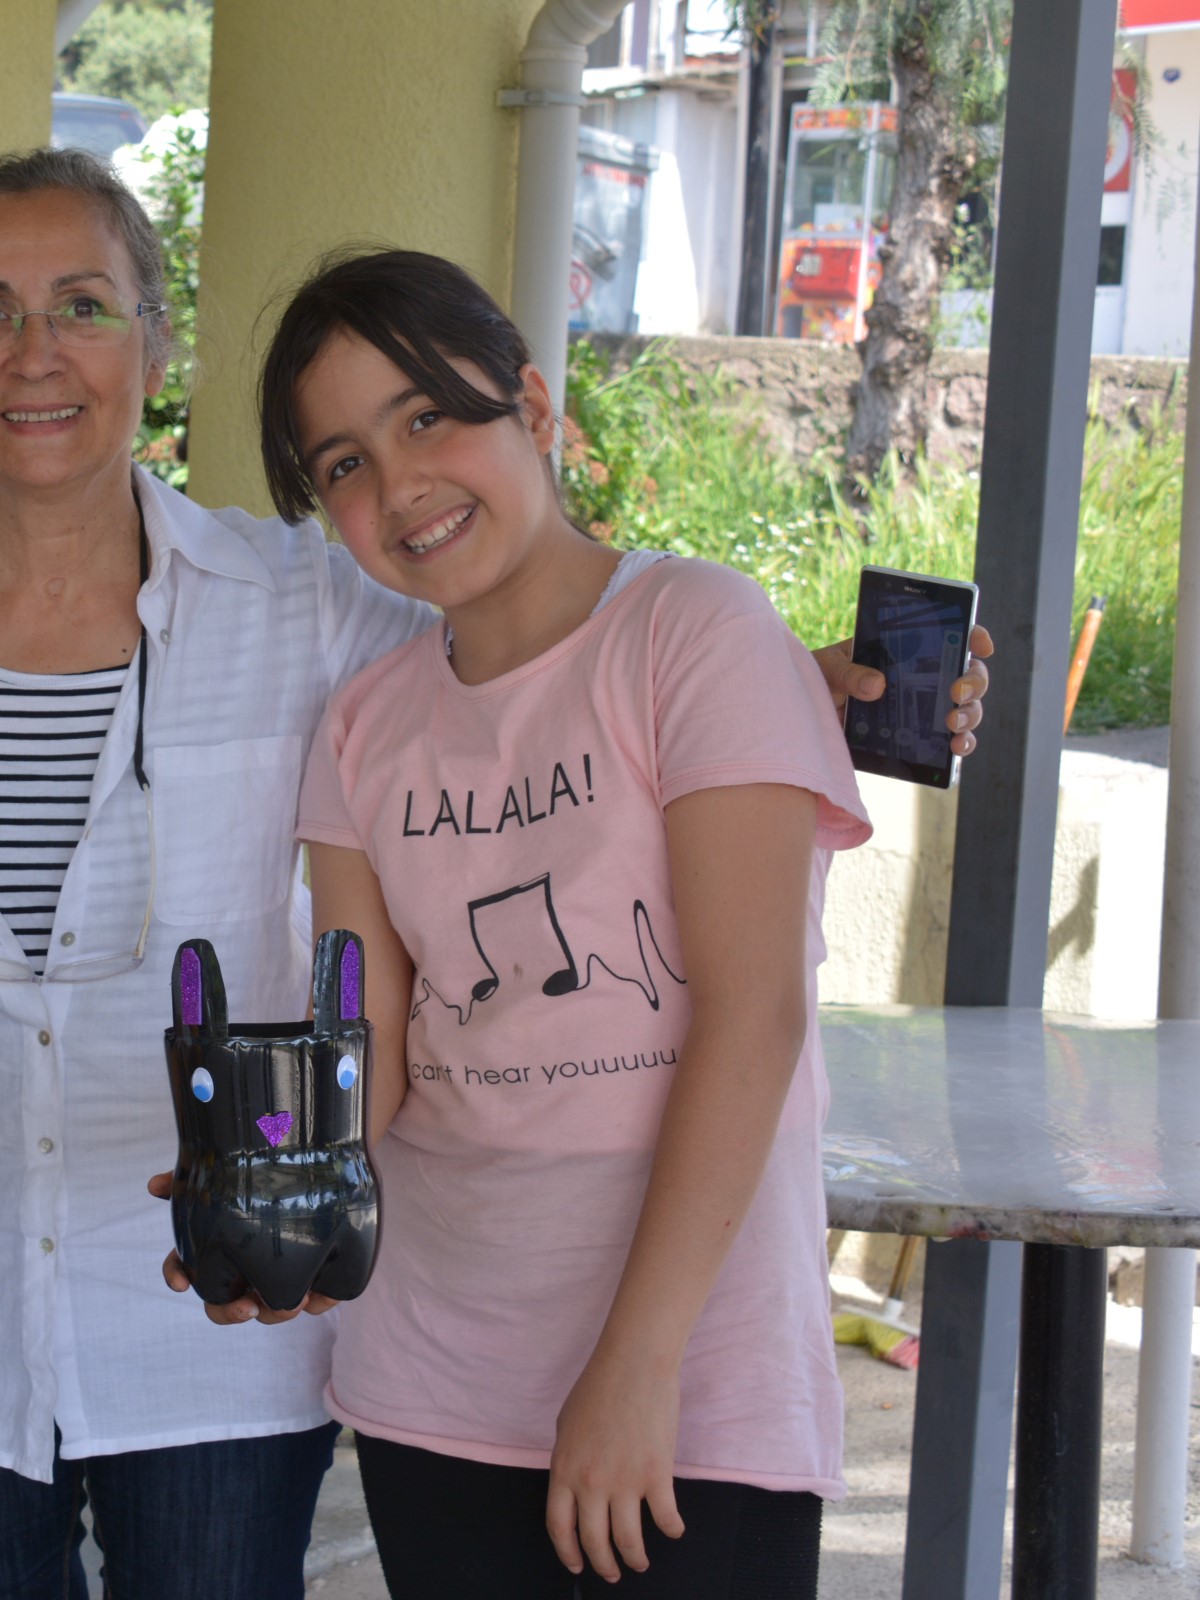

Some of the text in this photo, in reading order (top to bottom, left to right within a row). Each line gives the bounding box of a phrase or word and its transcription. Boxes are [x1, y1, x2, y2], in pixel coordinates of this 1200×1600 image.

[402, 754, 594, 837] LALALA!
[464, 1065, 531, 1085] hear
[541, 1048, 677, 1085] youuuuu
